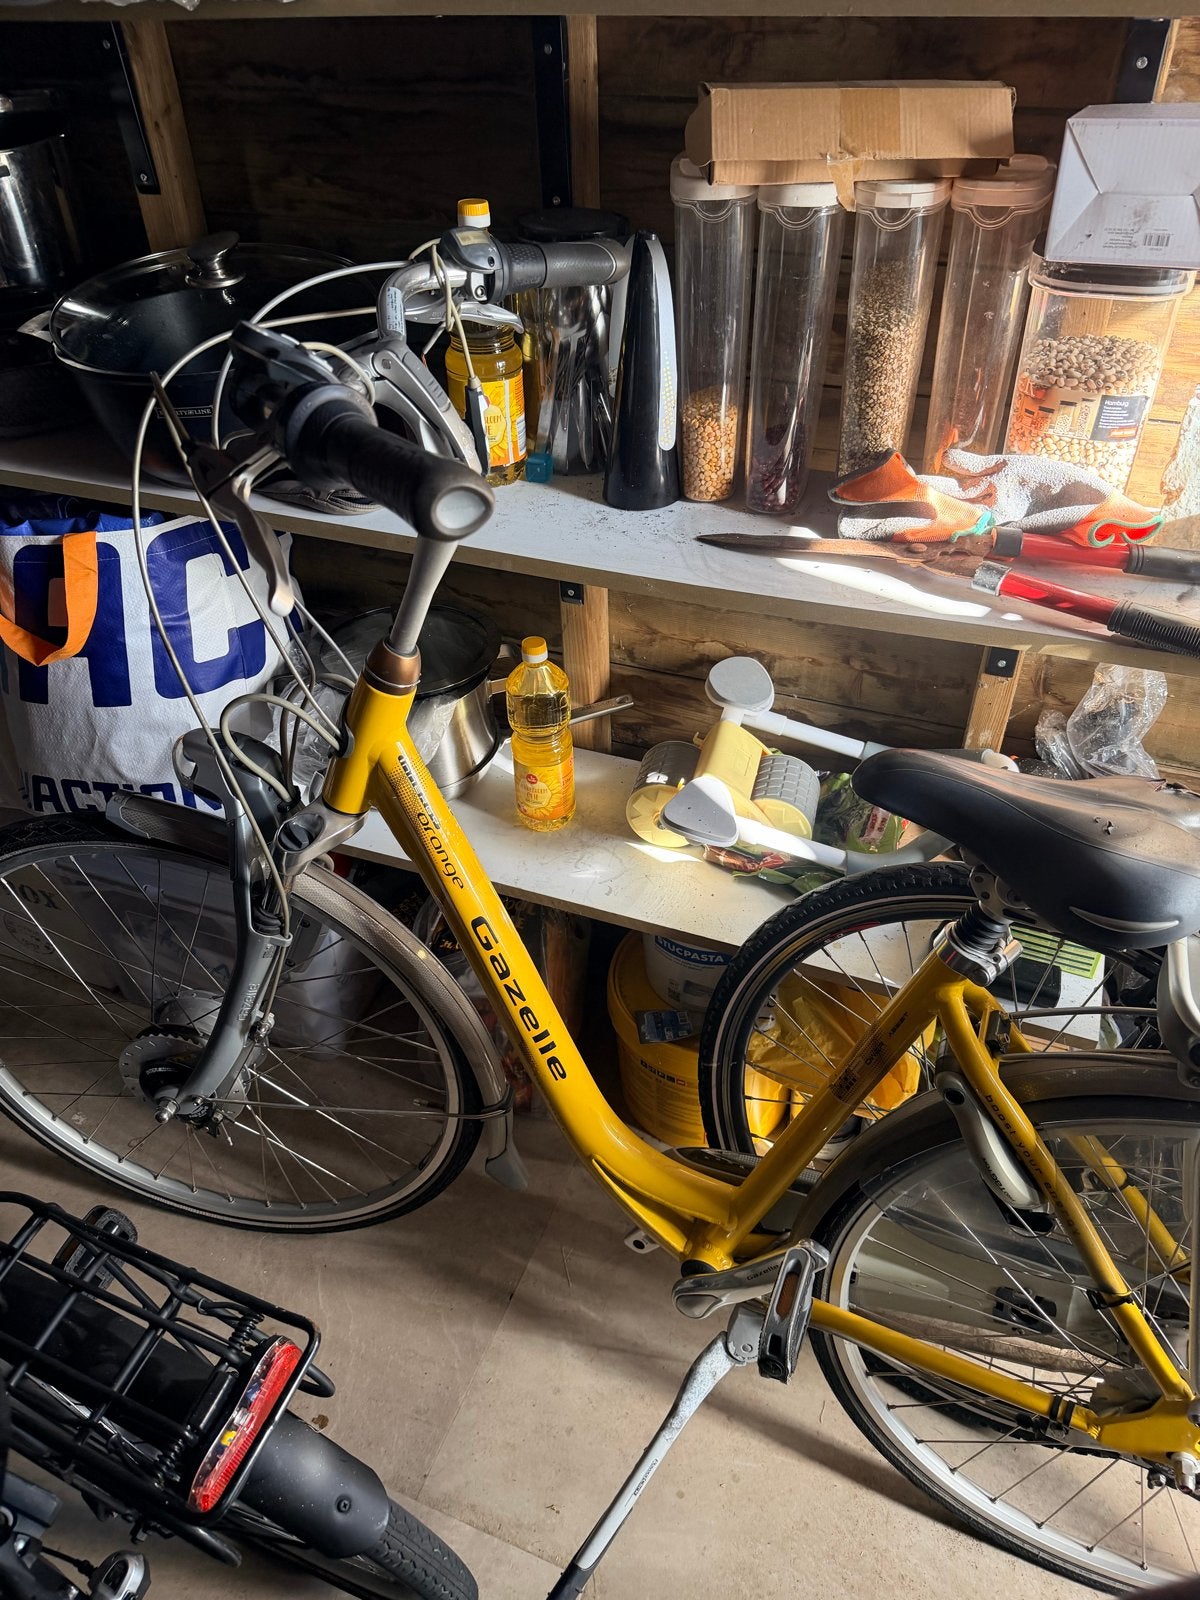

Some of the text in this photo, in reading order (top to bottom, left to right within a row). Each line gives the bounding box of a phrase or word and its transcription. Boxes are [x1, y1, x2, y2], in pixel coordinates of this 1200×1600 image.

[418, 811, 464, 889] orange
[470, 915, 567, 1081] Gazelle
[985, 1094, 1017, 1137] boost
[1016, 1142, 1043, 1175] your
[746, 1264, 780, 1281] Gazelle
